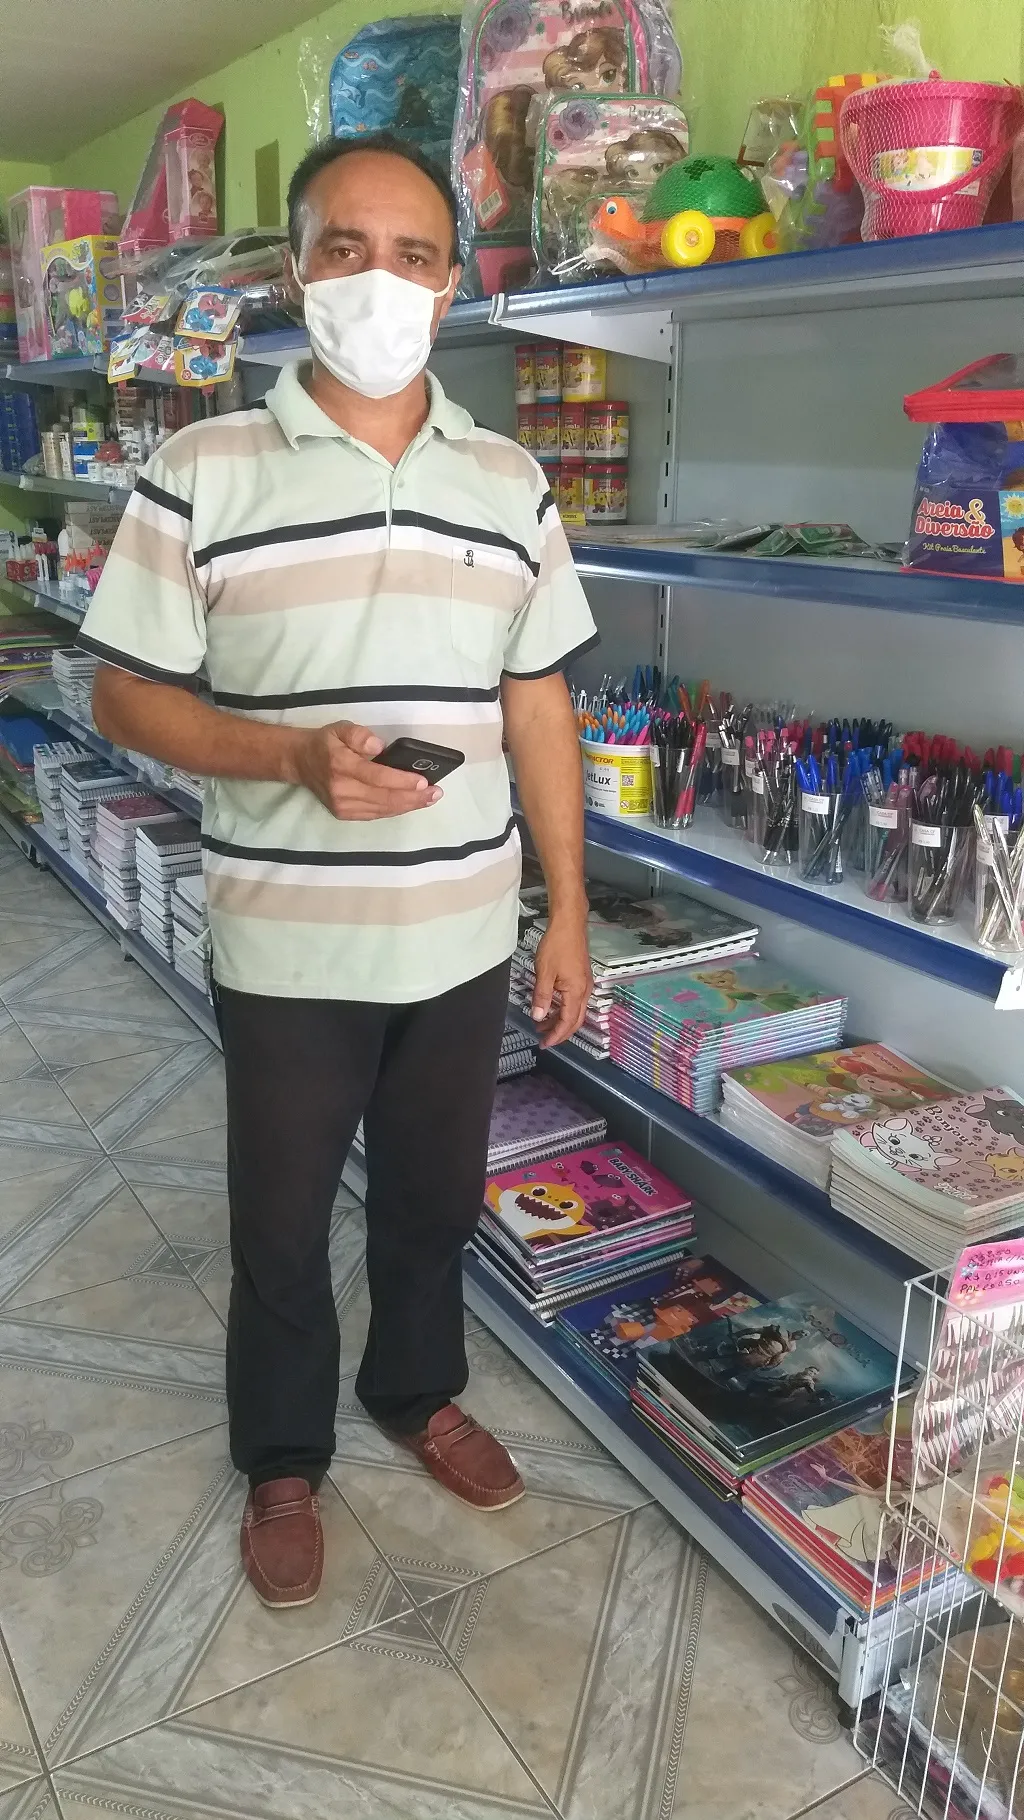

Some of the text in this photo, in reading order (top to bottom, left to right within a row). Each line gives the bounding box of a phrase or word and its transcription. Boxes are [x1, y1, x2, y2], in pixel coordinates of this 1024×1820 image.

[915, 515, 995, 539] Diversão
[917, 497, 986, 526] Areia &
[924, 1105, 979, 1148] Bonjour
[609, 1157, 657, 1196] BABY SHARK
